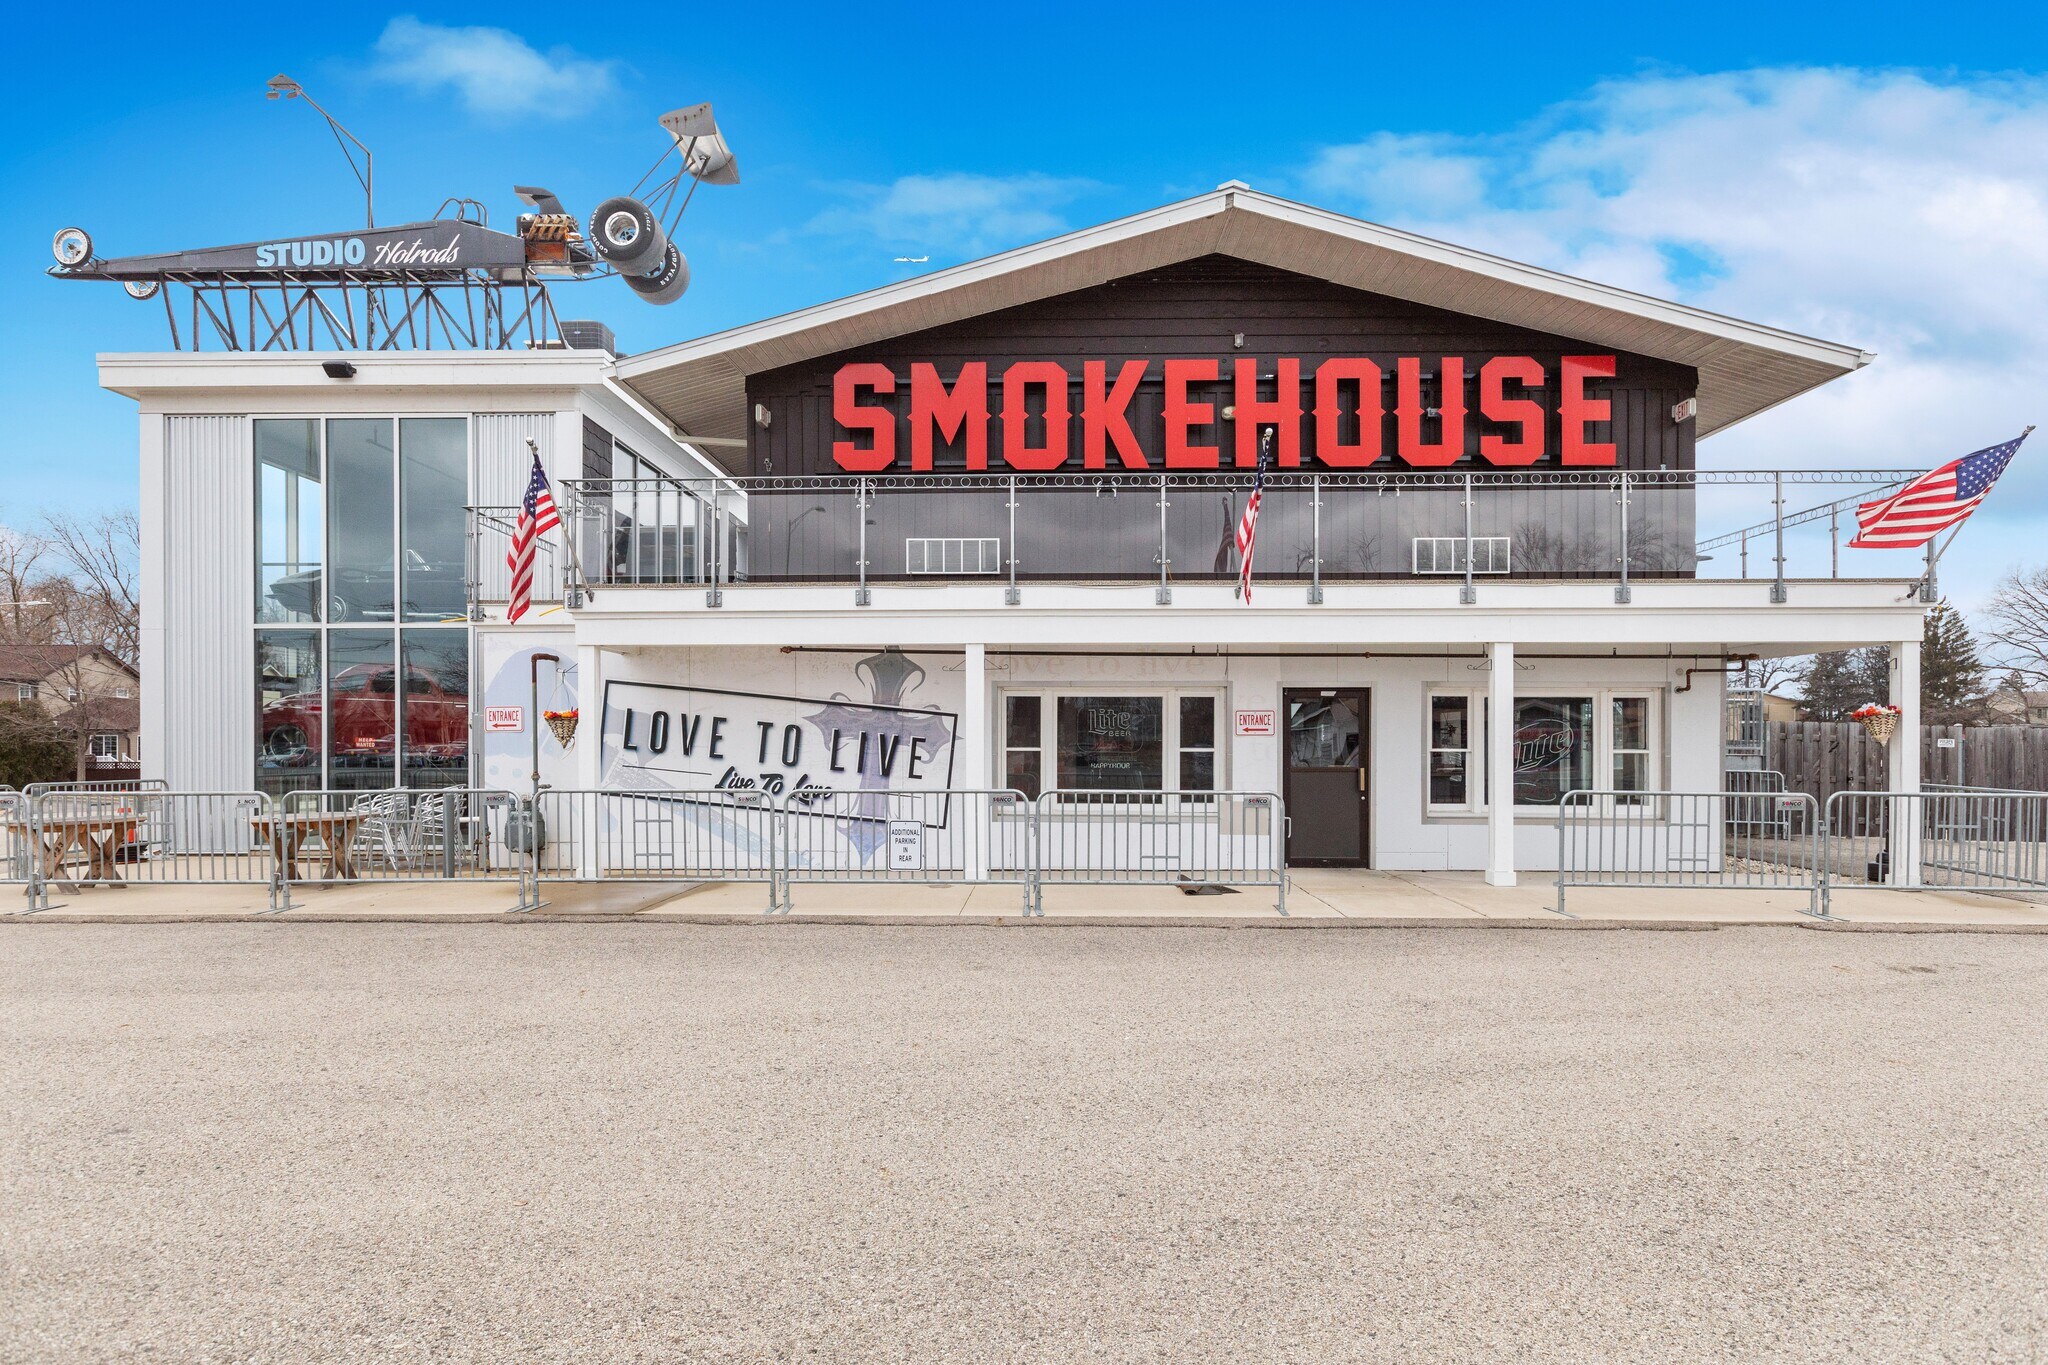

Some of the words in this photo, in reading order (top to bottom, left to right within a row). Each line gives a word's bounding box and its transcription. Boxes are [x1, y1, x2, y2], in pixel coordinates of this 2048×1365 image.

[256, 238, 366, 267] STUDIO
[373, 233, 460, 264] Hotrods
[659, 242, 678, 286] GOODYEAR
[832, 355, 1617, 471] SMOKEHOUSE
[489, 711, 520, 721] ENTRANCE
[1088, 709, 1131, 735] Lite
[1239, 715, 1271, 725] ENTRANCE
[622, 707, 727, 759] LOVE
[756, 720, 802, 767] TO
[830, 727, 926, 780] LIVE
[714, 766, 756, 797] Live
[760, 773, 784, 795] To
[790, 773, 833, 806] Love
